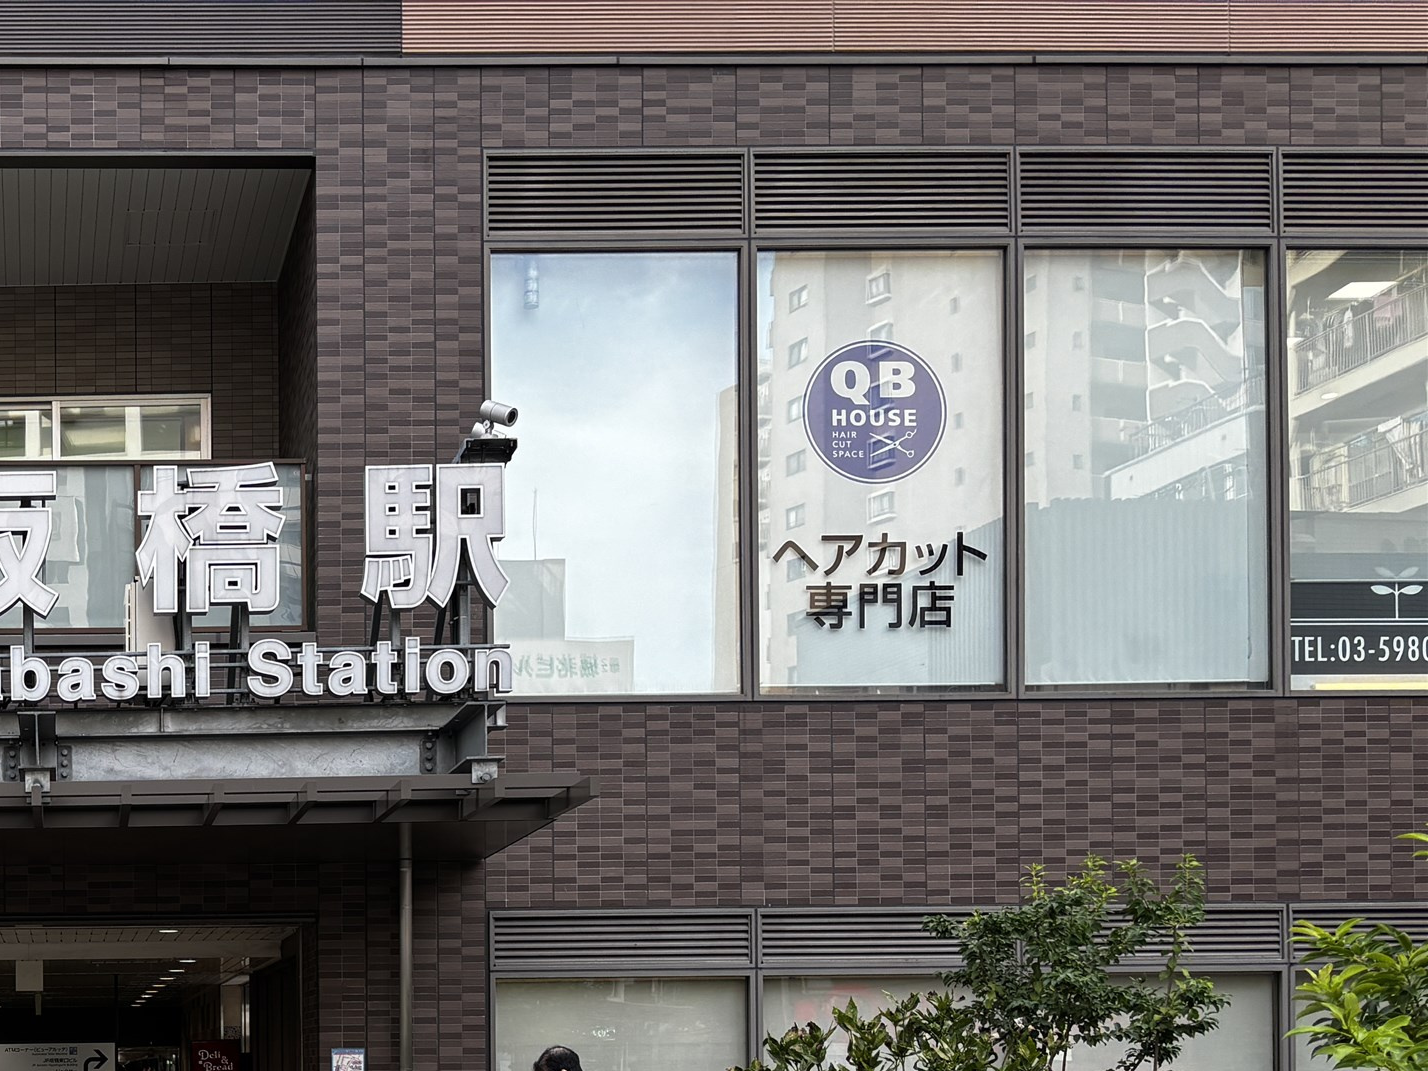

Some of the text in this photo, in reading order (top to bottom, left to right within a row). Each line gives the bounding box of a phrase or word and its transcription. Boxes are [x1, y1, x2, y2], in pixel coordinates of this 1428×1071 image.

[830, 361, 916, 405] QB
[832, 409, 917, 427] HOUSE
[832, 431, 857, 439] HAIR
[832, 450, 865, 458] SPACE
[773, 531, 987, 577] ヘアカット
[806, 581, 955, 630] 専門店
[247, 637, 513, 698] Station
[198, 1049, 221, 1060] Deli
[203, 1061, 234, 1071] Bread
